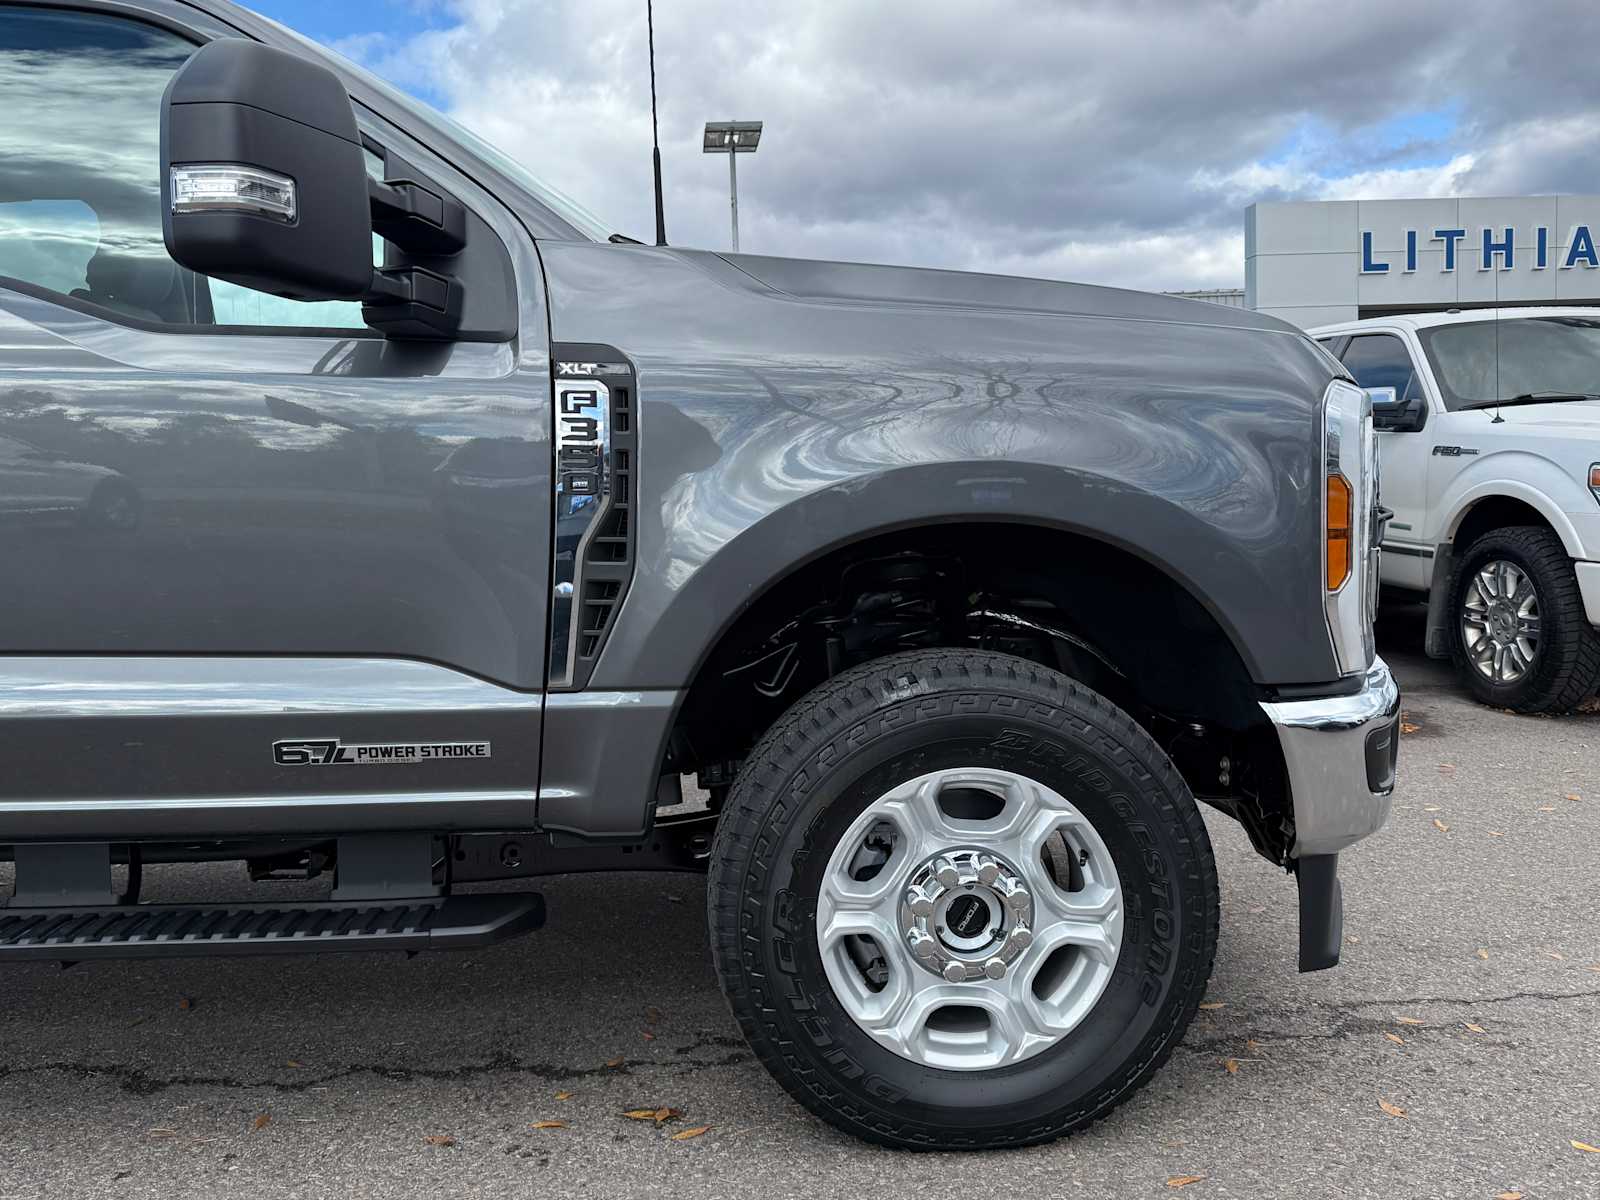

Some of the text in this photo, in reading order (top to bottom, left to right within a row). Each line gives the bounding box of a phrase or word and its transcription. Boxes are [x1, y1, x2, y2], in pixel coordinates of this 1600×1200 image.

[1361, 225, 1600, 273] LITHIA
[559, 362, 597, 375] XLT
[273, 740, 355, 764] 6.7L
[357, 746, 417, 759] POWER
[420, 744, 486, 757] STROKE
[990, 727, 1179, 1009] BRIDGESTONE
[958, 901, 980, 931] FORD
